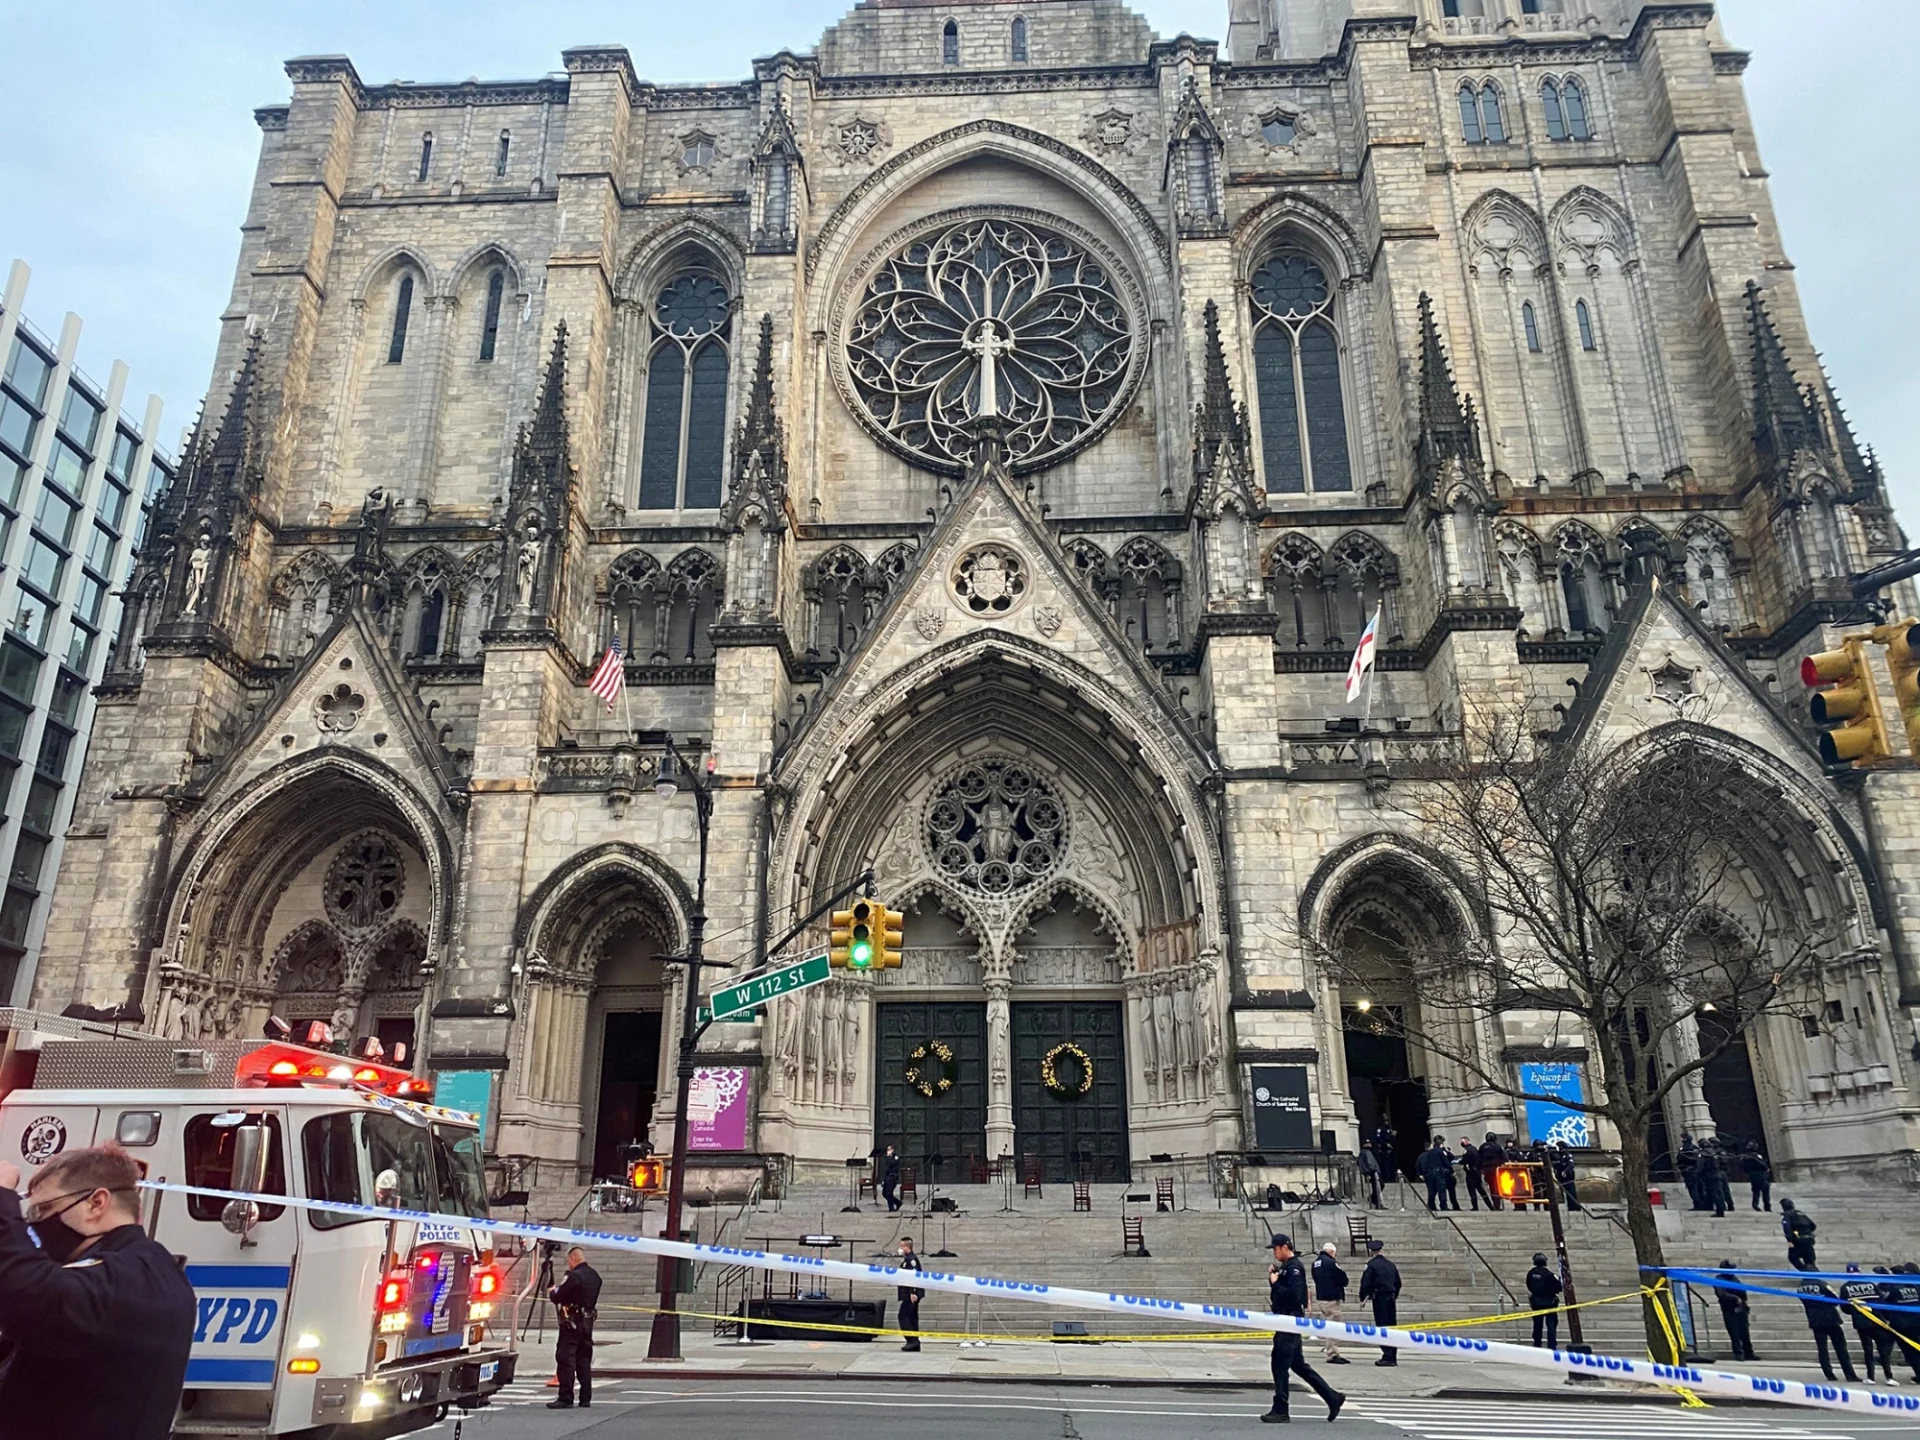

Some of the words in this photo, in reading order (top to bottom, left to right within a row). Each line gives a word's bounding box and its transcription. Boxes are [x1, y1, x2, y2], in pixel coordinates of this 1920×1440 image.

[736, 987, 751, 1004] W
[758, 976, 782, 997] 112
[789, 968, 805, 986] St
[420, 1232, 460, 1241] POLICE
[432, 1252, 455, 1333] 2
[1846, 1283, 1875, 1293] NYPD
[1848, 1289, 1877, 1297] POLICE
[193, 1297, 278, 1344] YPD
